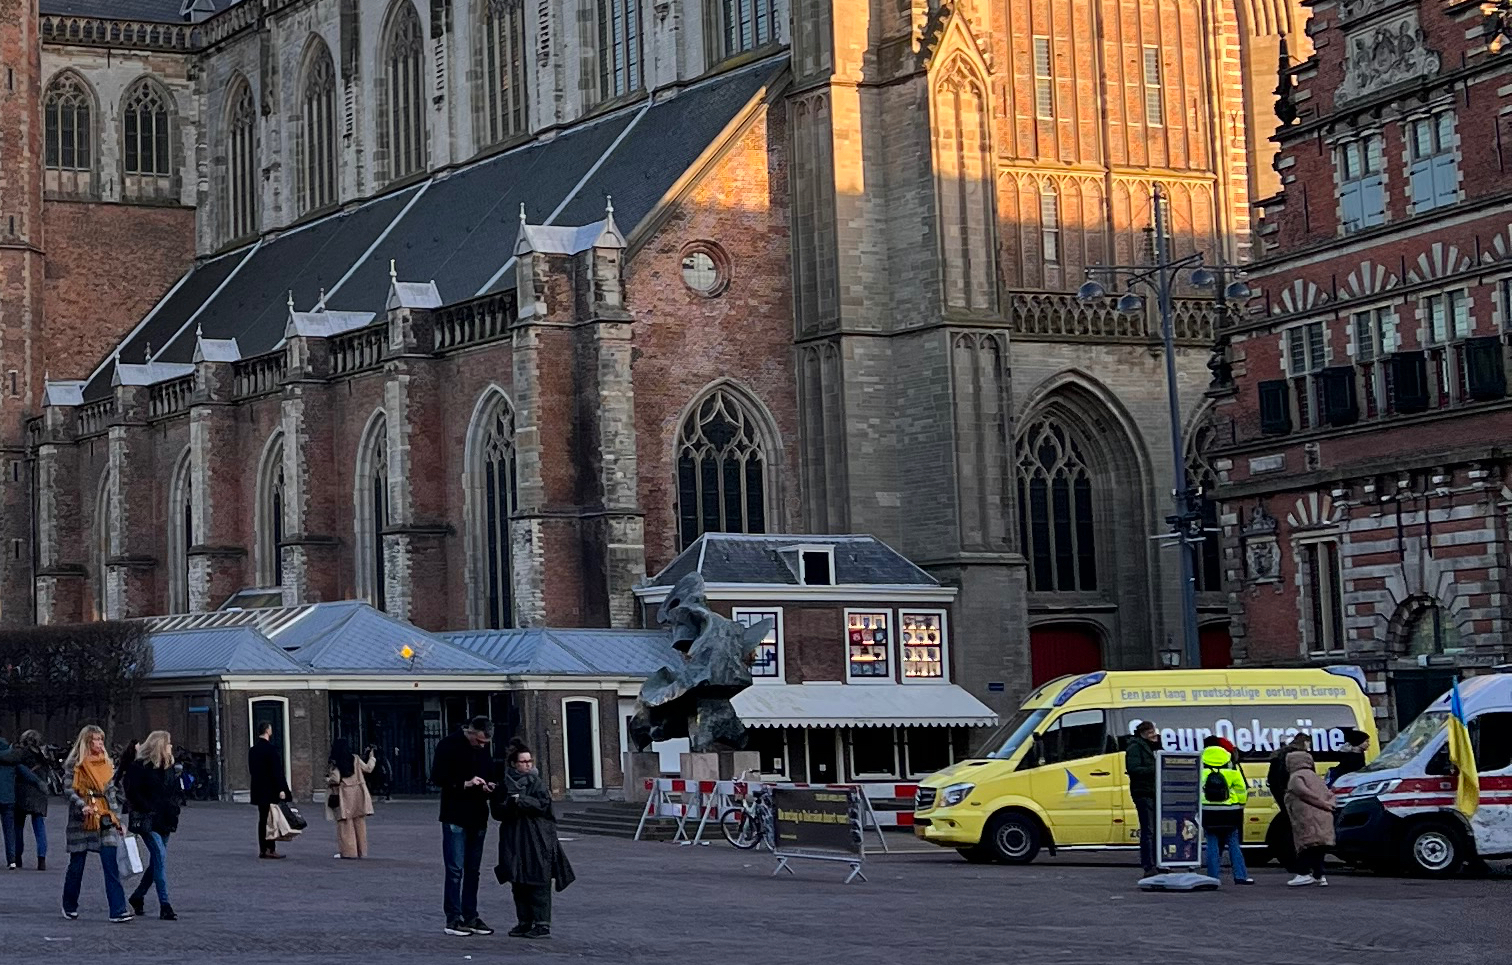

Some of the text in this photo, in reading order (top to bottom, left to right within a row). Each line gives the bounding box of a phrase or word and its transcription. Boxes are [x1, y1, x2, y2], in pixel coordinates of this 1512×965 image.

[1120, 685, 1347, 702] Een jaar lang grootschalige oorlog in Europa
[1128, 719, 1211, 752] eun
